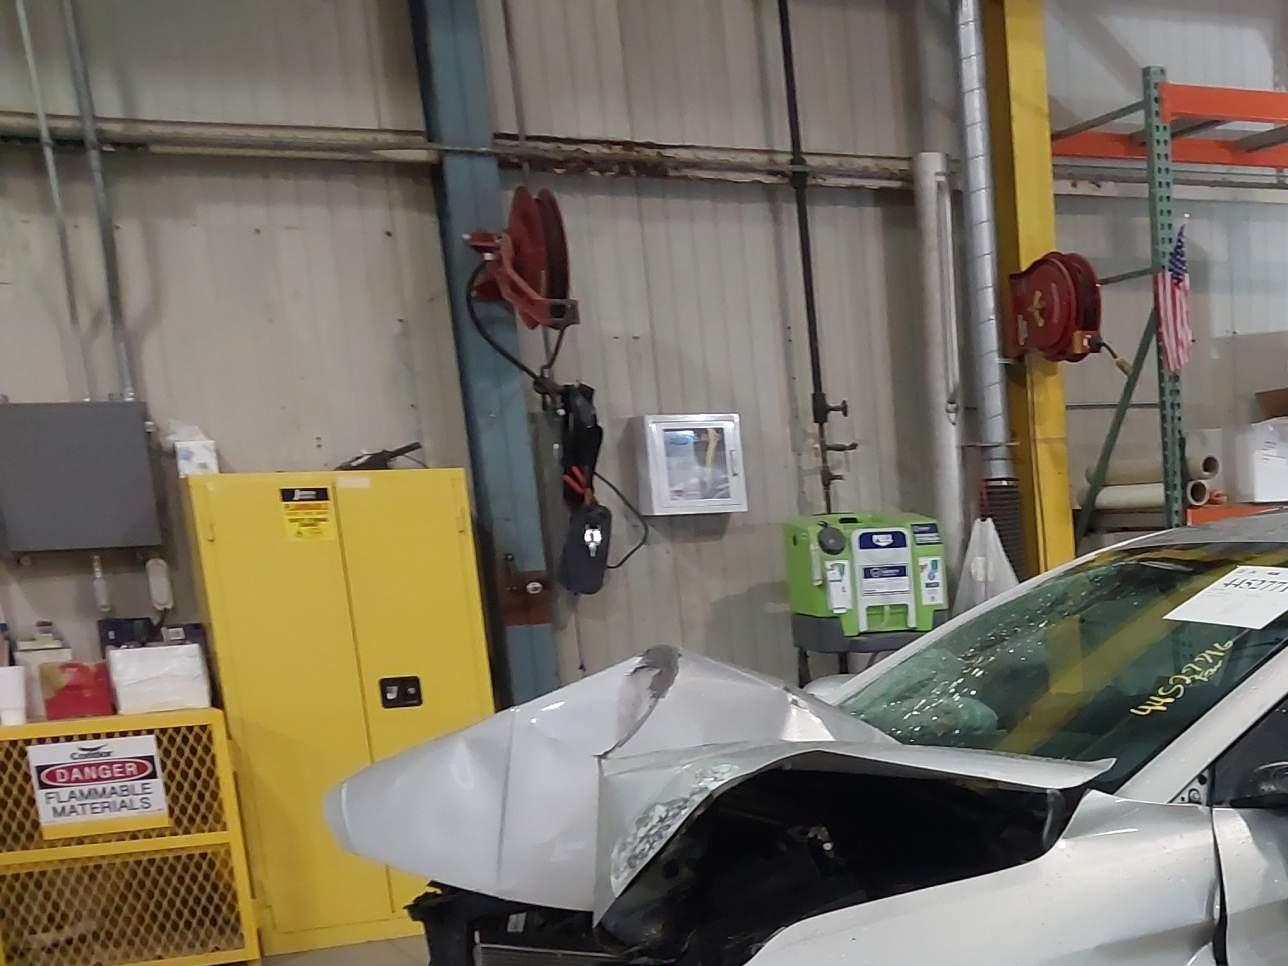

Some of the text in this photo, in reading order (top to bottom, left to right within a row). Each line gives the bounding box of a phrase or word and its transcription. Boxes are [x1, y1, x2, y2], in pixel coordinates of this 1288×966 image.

[55, 762, 139, 783] DANGER
[44, 782, 152, 805] FLAMMABLE
[52, 796, 152, 818] MATERIALS
